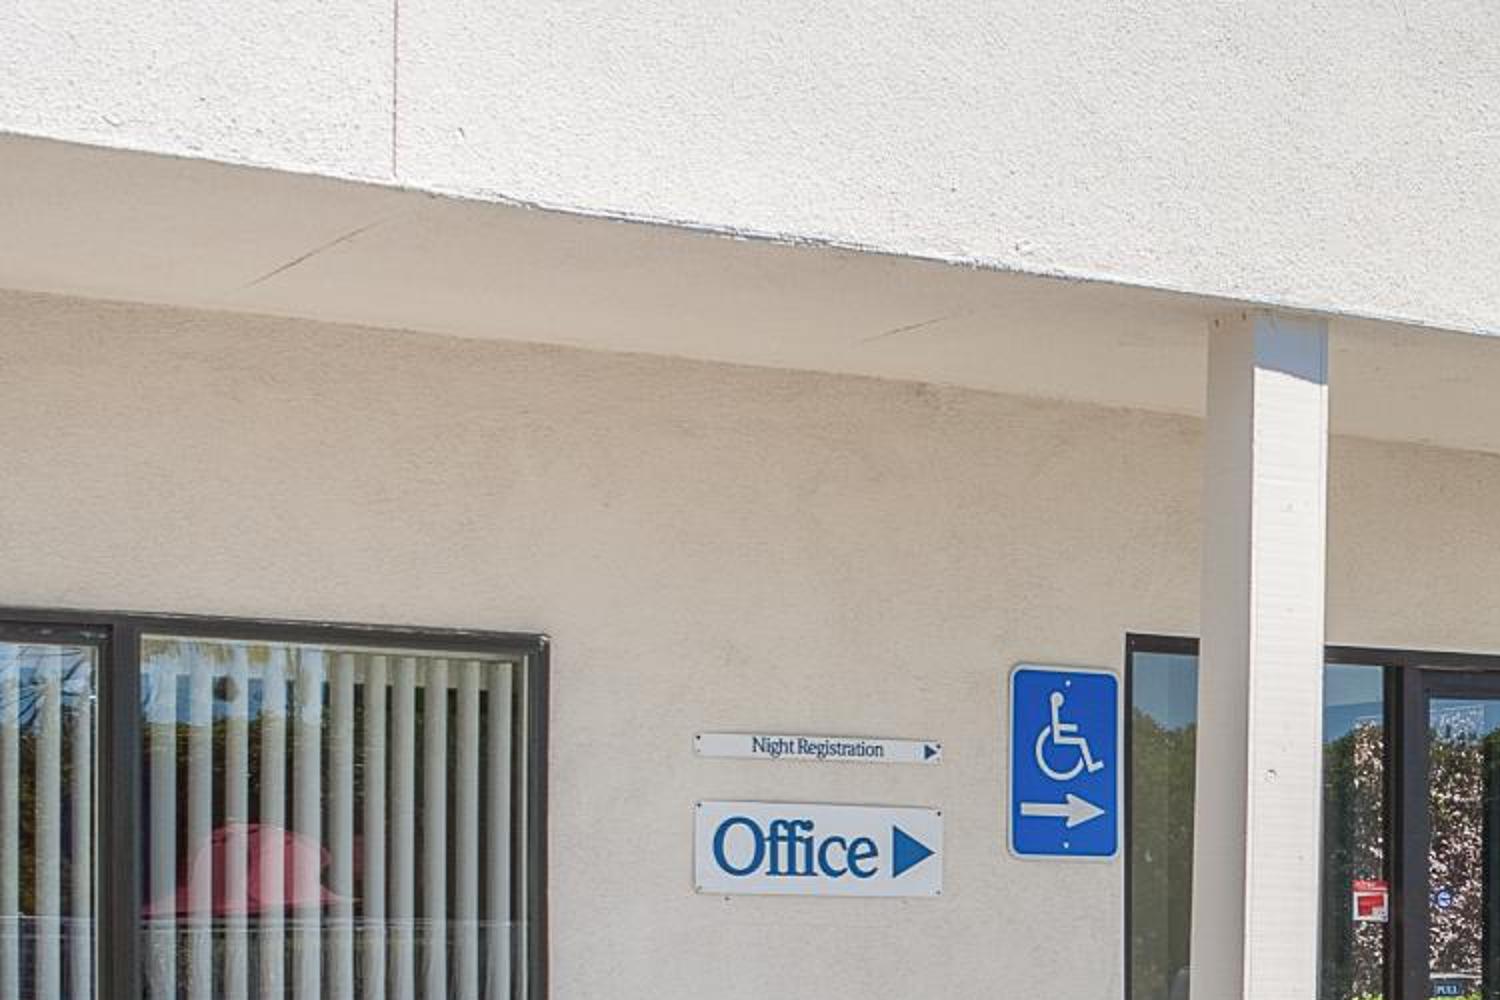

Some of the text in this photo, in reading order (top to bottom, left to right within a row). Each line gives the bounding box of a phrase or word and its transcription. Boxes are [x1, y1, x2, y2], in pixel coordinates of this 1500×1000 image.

[752, 736, 884, 761] Night Registration
[713, 816, 879, 878] Office
